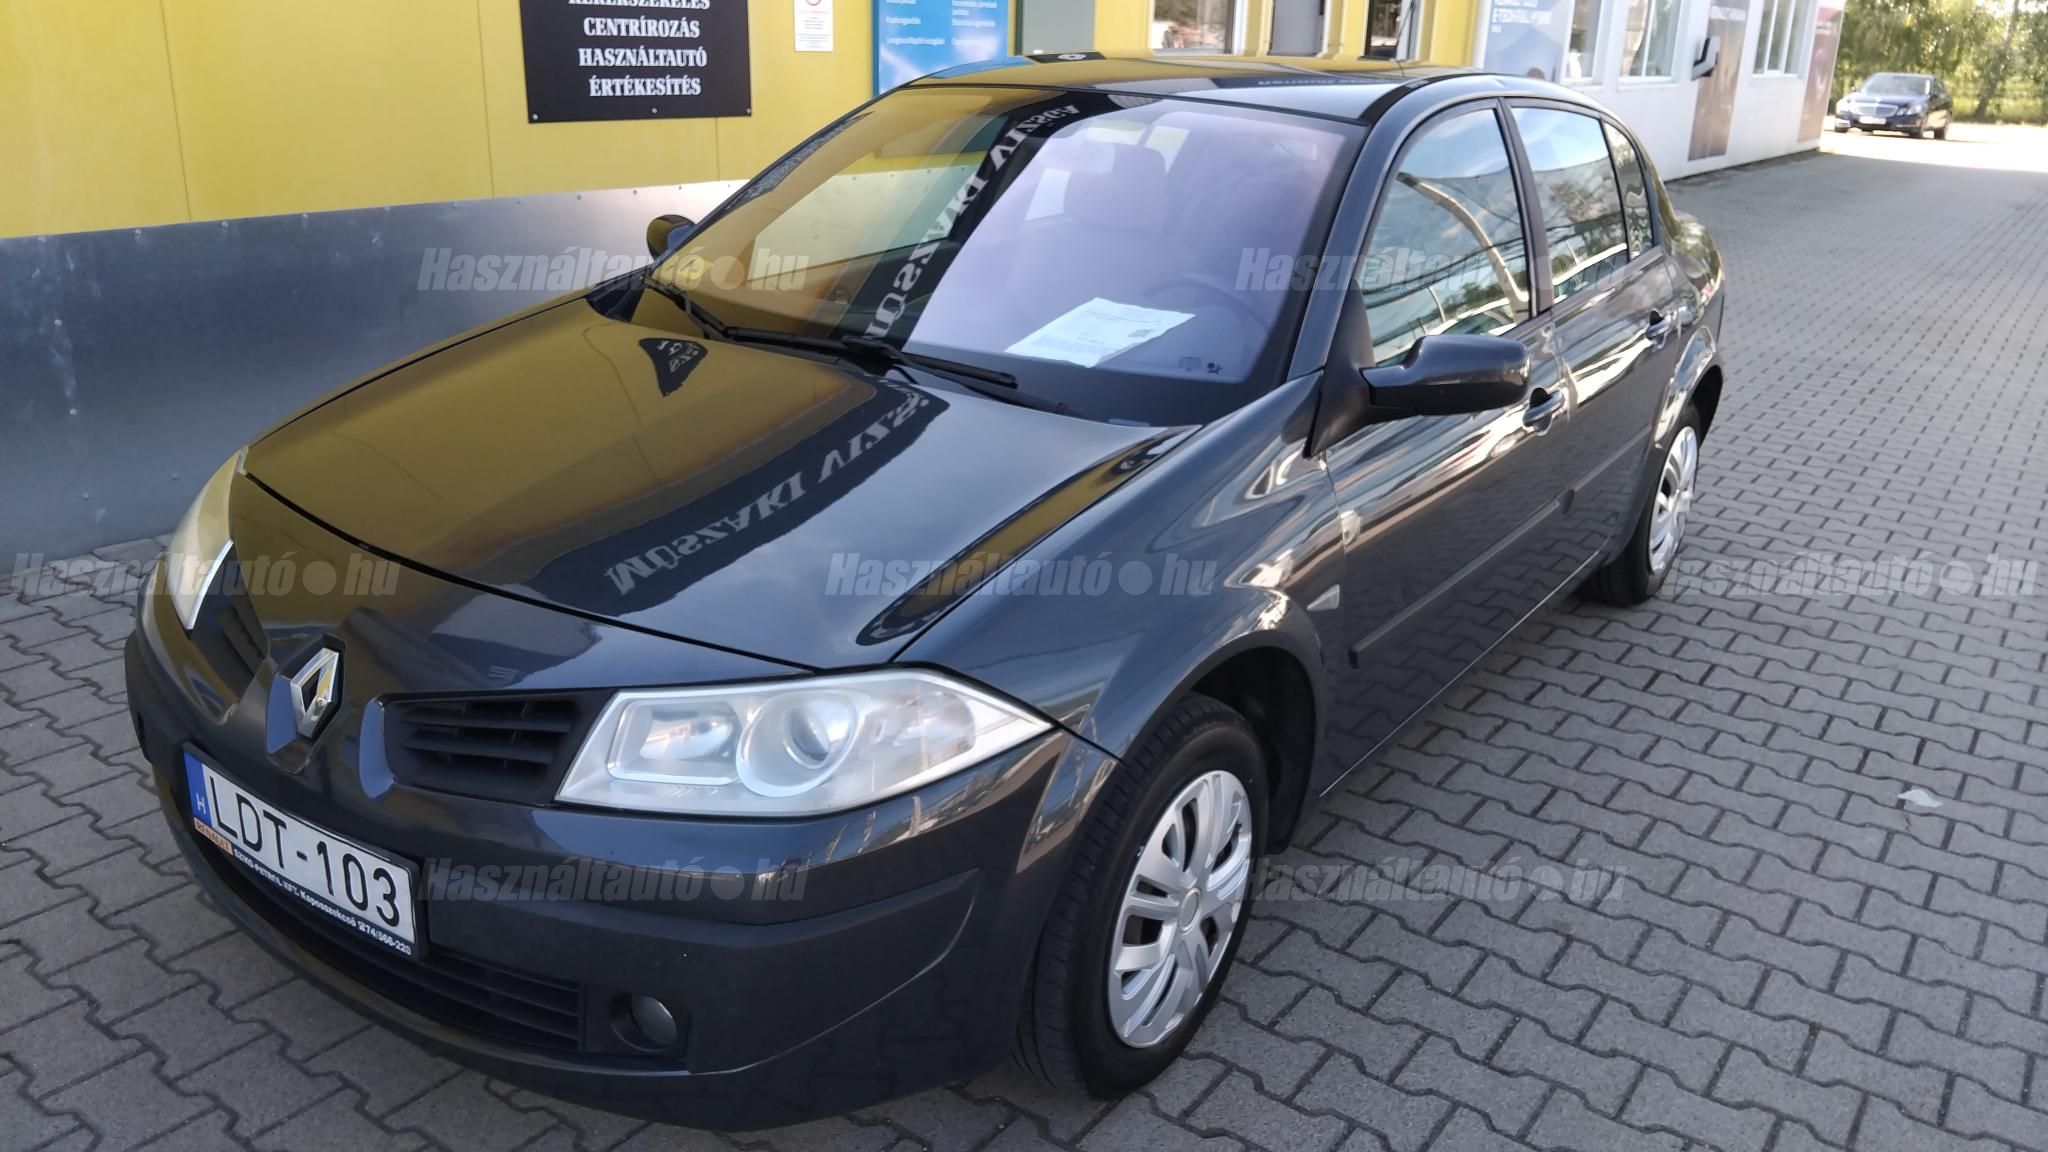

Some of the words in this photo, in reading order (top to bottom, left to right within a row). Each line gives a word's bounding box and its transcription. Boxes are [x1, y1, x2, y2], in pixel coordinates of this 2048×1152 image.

[583, 16, 700, 38] CENTRÍROZÁS
[578, 45, 707, 67] HASZNÁLTAUTÓ
[589, 75, 702, 97] ÉRTÉKESÍTÉS
[194, 792, 208, 816] H
[209, 776, 401, 928] LDT-103
